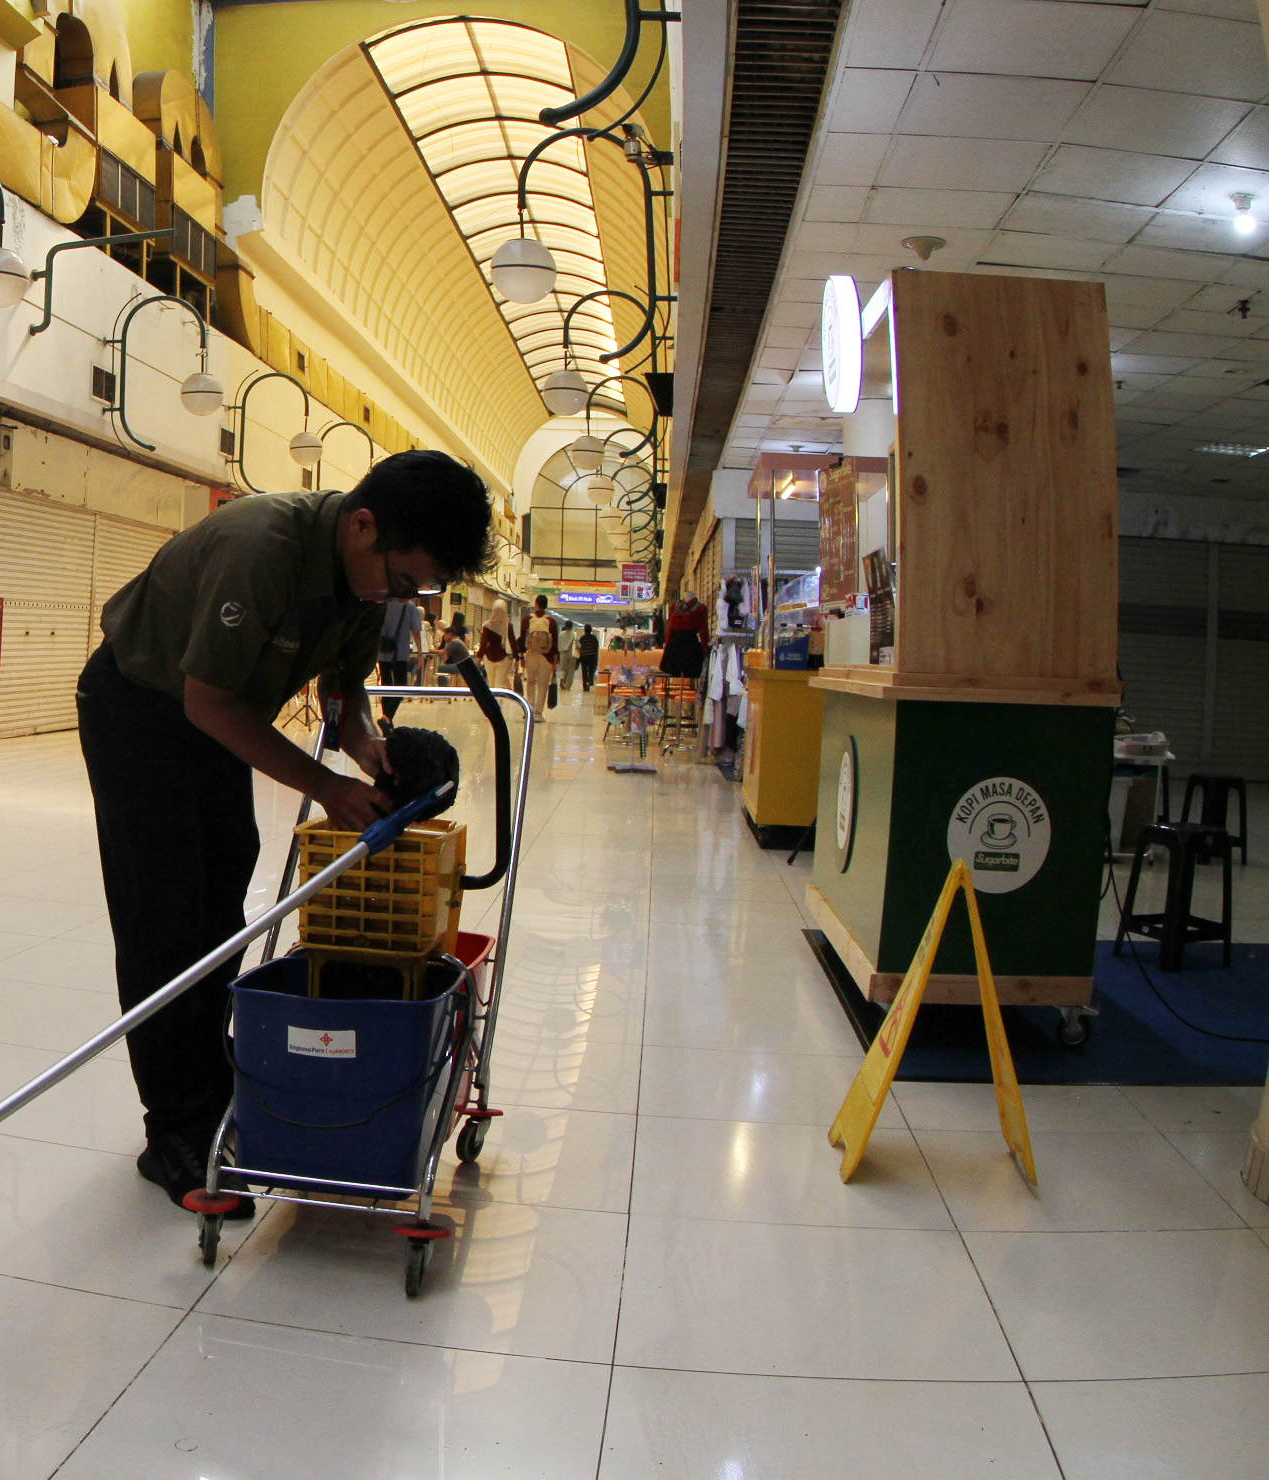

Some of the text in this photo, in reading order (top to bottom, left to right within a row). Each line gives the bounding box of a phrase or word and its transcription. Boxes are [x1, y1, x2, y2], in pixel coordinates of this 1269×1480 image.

[954, 782, 1045, 825] KOPI MASA DEPAN
[975, 853, 1019, 866] Sugarbite
[289, 1044, 311, 1053] Angkasa
